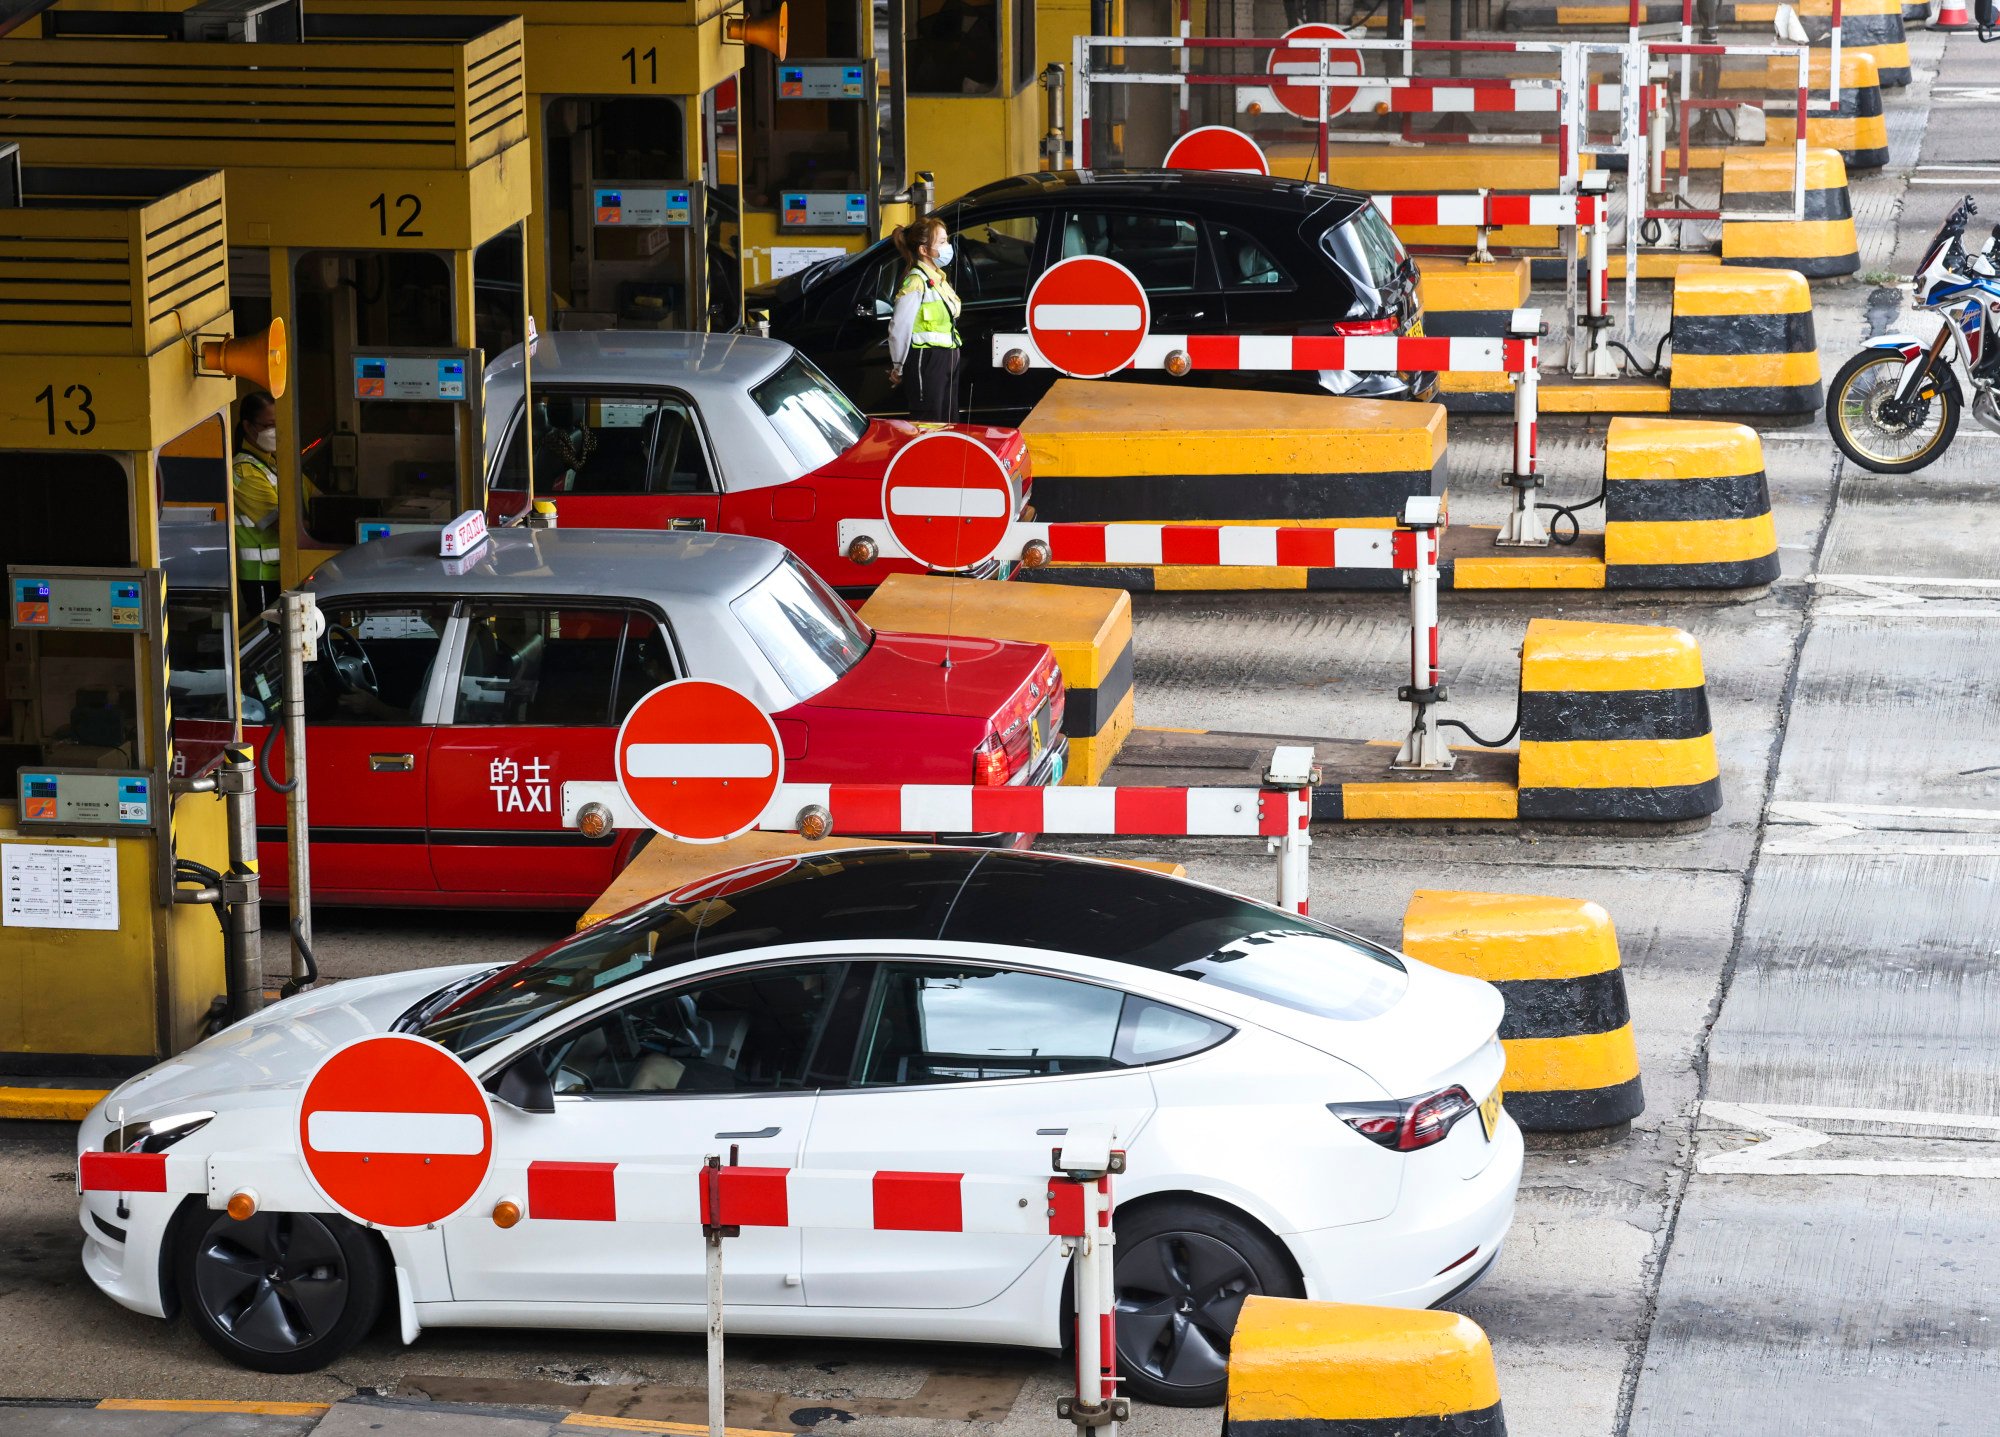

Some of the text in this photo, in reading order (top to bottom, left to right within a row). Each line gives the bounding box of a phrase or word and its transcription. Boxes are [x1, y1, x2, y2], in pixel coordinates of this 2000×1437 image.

[622, 46, 657, 84] 11
[369, 192, 423, 237] 12
[35, 383, 96, 436] 13
[458, 513, 484, 546] TAXI
[489, 756, 551, 784] 的士
[489, 785, 552, 812] TAXI
